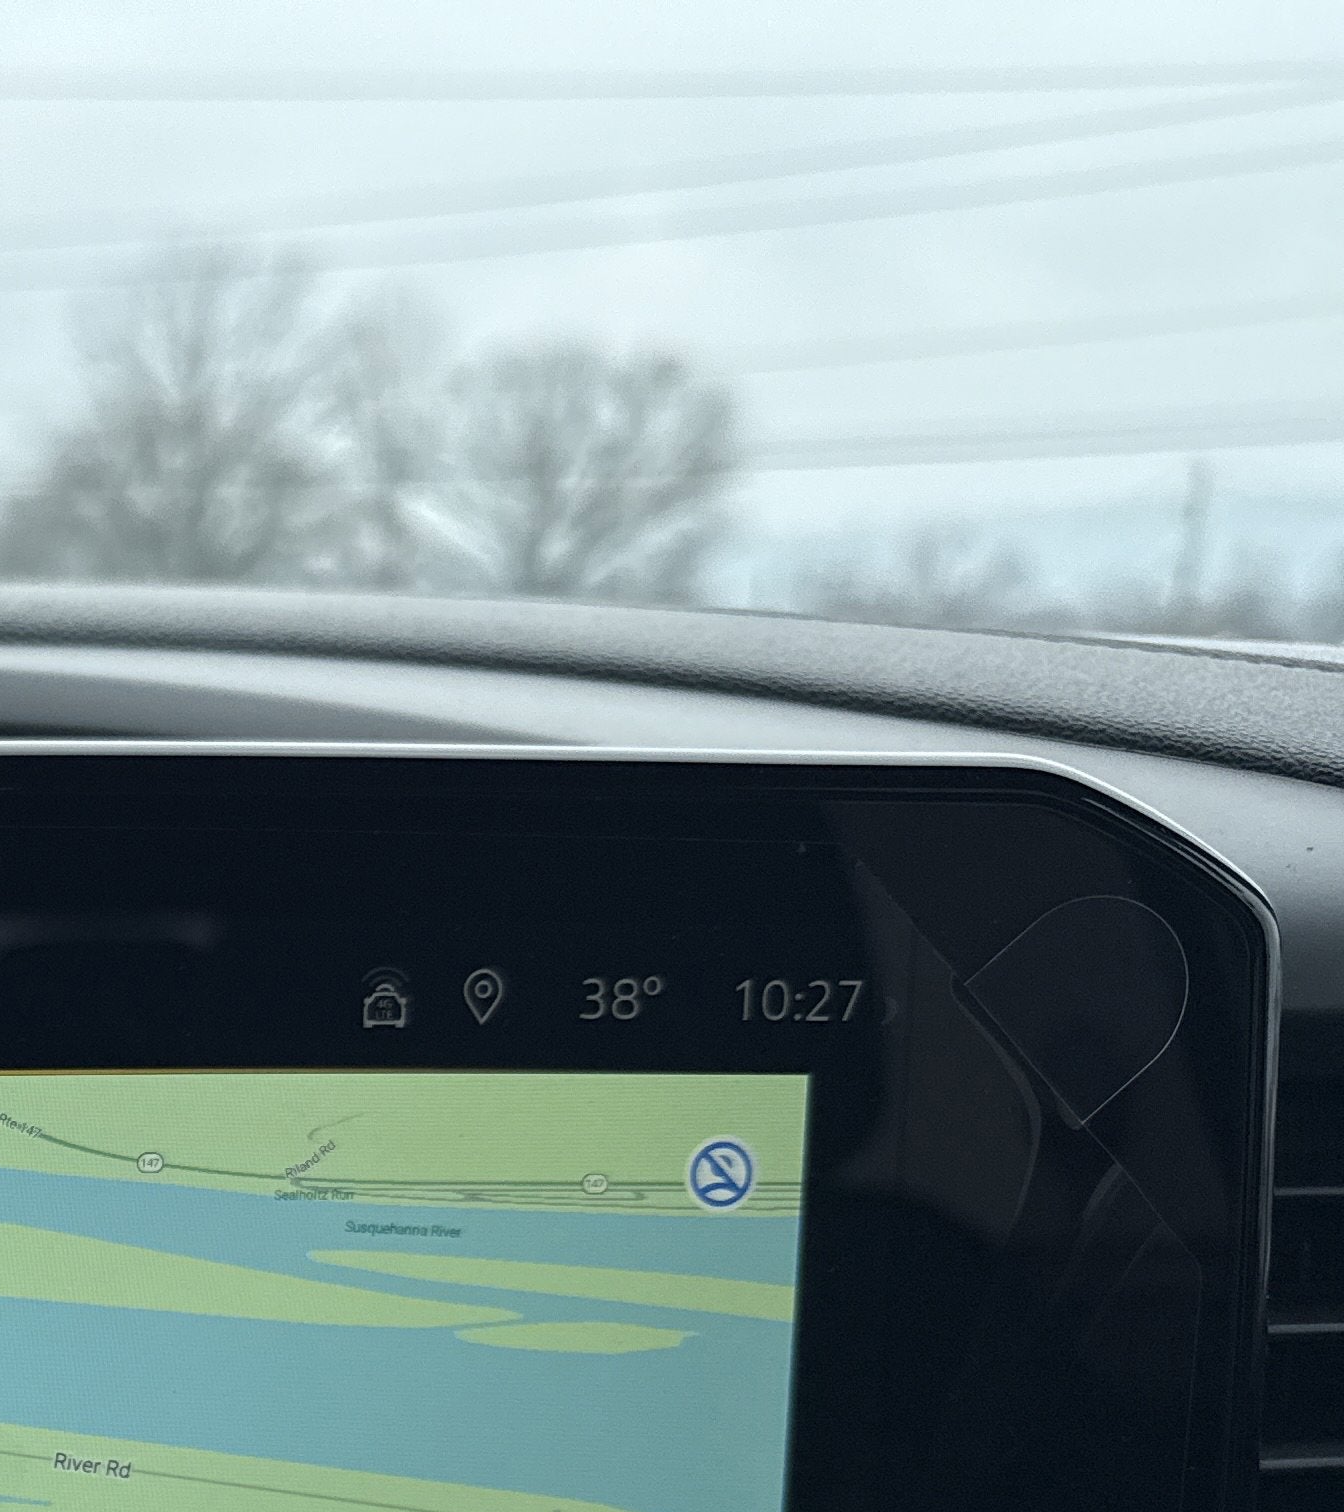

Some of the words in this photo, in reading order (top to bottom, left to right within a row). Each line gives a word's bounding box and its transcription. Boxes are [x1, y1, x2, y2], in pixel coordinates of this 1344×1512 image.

[376, 999, 393, 1009] 4G
[578, 976, 662, 1020] 38°
[734, 979, 863, 1022] 10:27
[20, 1121, 42, 1139] 147
[318, 1139, 337, 1159] Rd
[141, 1158, 160, 1168] 147
[344, 1220, 428, 1237] Susquehanna
[431, 1224, 462, 1239] River
[53, 1452, 102, 1477] River
[106, 1459, 132, 1479] Rd
